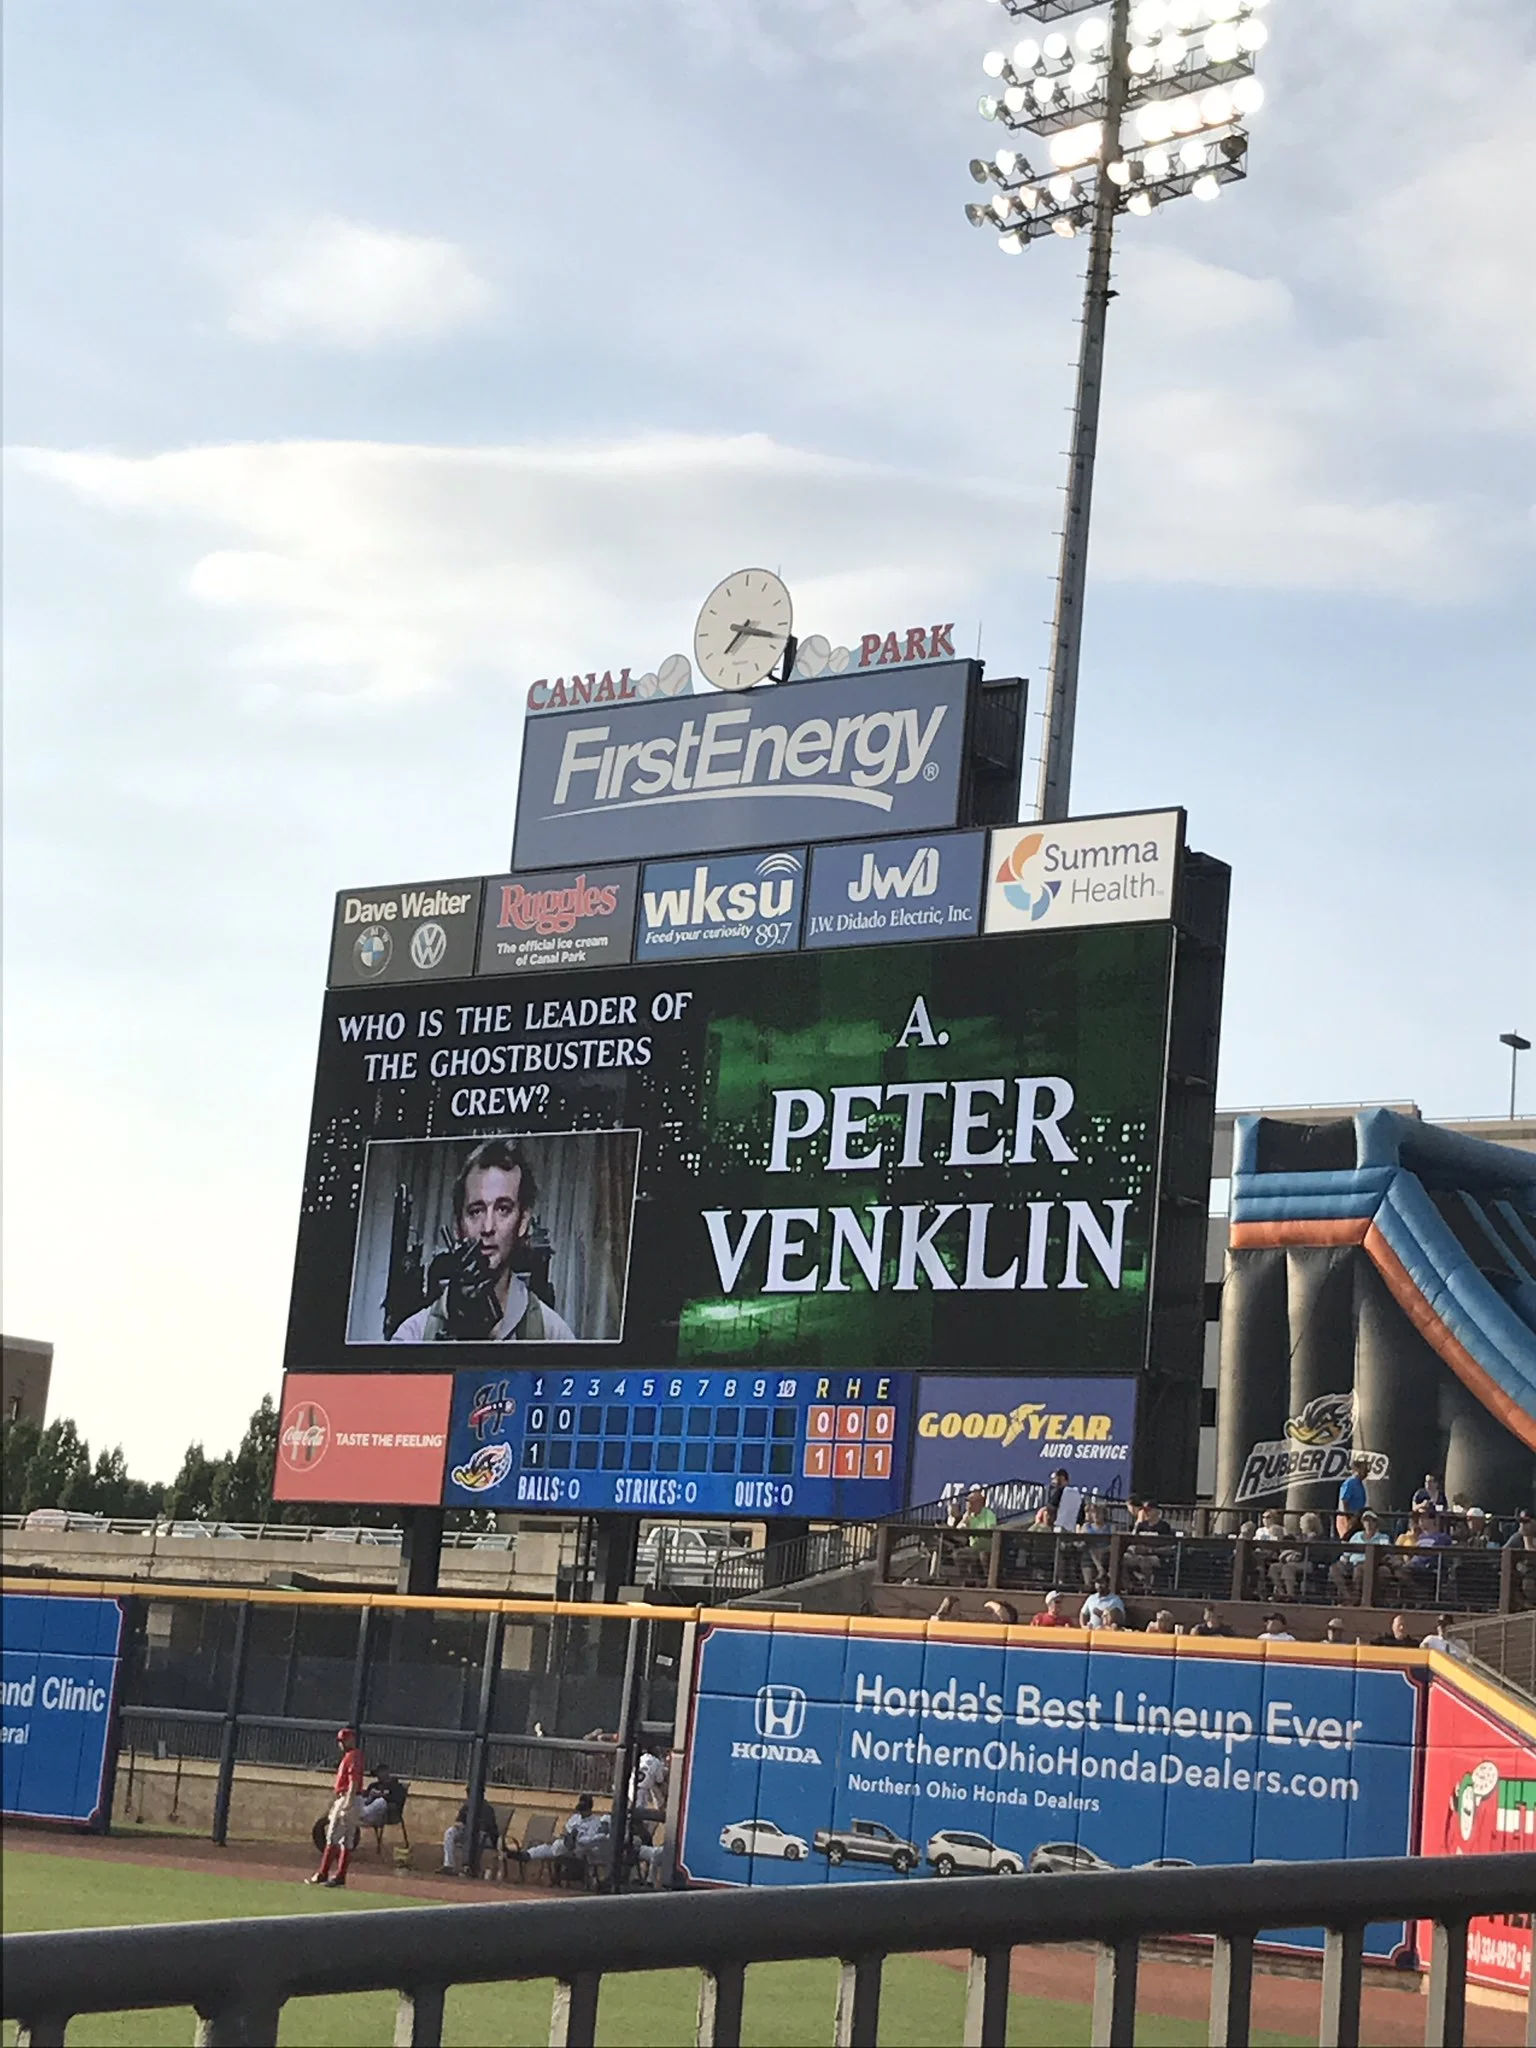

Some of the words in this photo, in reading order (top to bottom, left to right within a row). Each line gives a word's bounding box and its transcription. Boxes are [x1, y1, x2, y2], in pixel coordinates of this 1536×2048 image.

[527, 668, 636, 711] CANAL
[858, 623, 955, 667] PARK
[553, 705, 947, 804] FirstEnergy
[1043, 841, 1158, 872] Summa
[848, 848, 939, 902] JWD
[1071, 872, 1155, 904] Health
[344, 898, 397, 924] Dave
[401, 890, 471, 918] Walter
[497, 873, 619, 935] Ruggles
[643, 866, 794, 928] wksu
[645, 929, 675, 944] Feed
[675, 930, 701, 944] your
[703, 923, 753, 939] curiosity
[754, 922, 793, 948] 89.7
[836, 910, 886, 932] Didado
[890, 906, 943, 927] Electric,
[948, 905, 972, 922] Inc.
[497, 942, 517, 954] The
[519, 938, 556, 952] official
[557, 938, 573, 949] ice
[575, 936, 608, 948] cream
[515, 955, 528, 966] of
[530, 951, 559, 965] Canal
[561, 950, 586, 962] Park
[338, 1012, 405, 1042] WHO
[418, 1009, 444, 1038] IS
[456, 1005, 511, 1036] THE
[525, 995, 637, 1030] LEADER
[651, 992, 693, 1022] OF
[896, 995, 950, 1047] A.
[364, 1053, 417, 1082] THE
[430, 1036, 652, 1077] GHOSTBUSTERS
[450, 1084, 550, 1116] CREW?
[765, 1076, 1078, 1172] PETER
[701, 1199, 1133, 1293] VENKLIN
[533, 1378, 543, 1396] 1
[561, 1379, 574, 1396] 2
[588, 1379, 600, 1396] 3
[614, 1378, 626, 1396] 4
[642, 1379, 655, 1396] 5
[669, 1379, 682, 1396] 6
[698, 1379, 710, 1396] 7
[724, 1379, 736, 1397] 8
[753, 1379, 766, 1397] 9
[776, 1379, 797, 1397] 10
[816, 1378, 829, 1398] R
[846, 1378, 861, 1399] H
[877, 1378, 890, 1399] E
[532, 1408, 543, 1429] 0
[559, 1409, 571, 1429] 0
[817, 1412, 829, 1433] 0
[847, 1412, 859, 1433] 0
[876, 1413, 888, 1434] 0
[918, 1411, 1112, 1441] GOODYEAR
[336, 1433, 369, 1446] TASTE
[372, 1433, 393, 1447] THE
[394, 1434, 442, 1447] FEELING
[1040, 1443, 1072, 1458] AUTO
[1075, 1444, 1129, 1460] SERVICE
[530, 1443, 538, 1464] 1
[815, 1448, 824, 1470] 1
[845, 1449, 854, 1471] 1
[874, 1450, 883, 1472] 1
[42, 1676, 106, 1712] Clinic
[854, 1673, 1003, 1724] Honda's
[1016, 1684, 1102, 1731] Best
[1114, 1690, 1253, 1754] Lineup
[1266, 1701, 1362, 1750] Ever
[730, 1742, 822, 1765] HONDA
[851, 1730, 1359, 1801] NorthernOhioHondaDealers.com
[848, 1774, 920, 1797] Northern
[926, 1781, 967, 1800] Ohio
[973, 1785, 1027, 1806] Honda
[1034, 1789, 1099, 1813] Dealers
